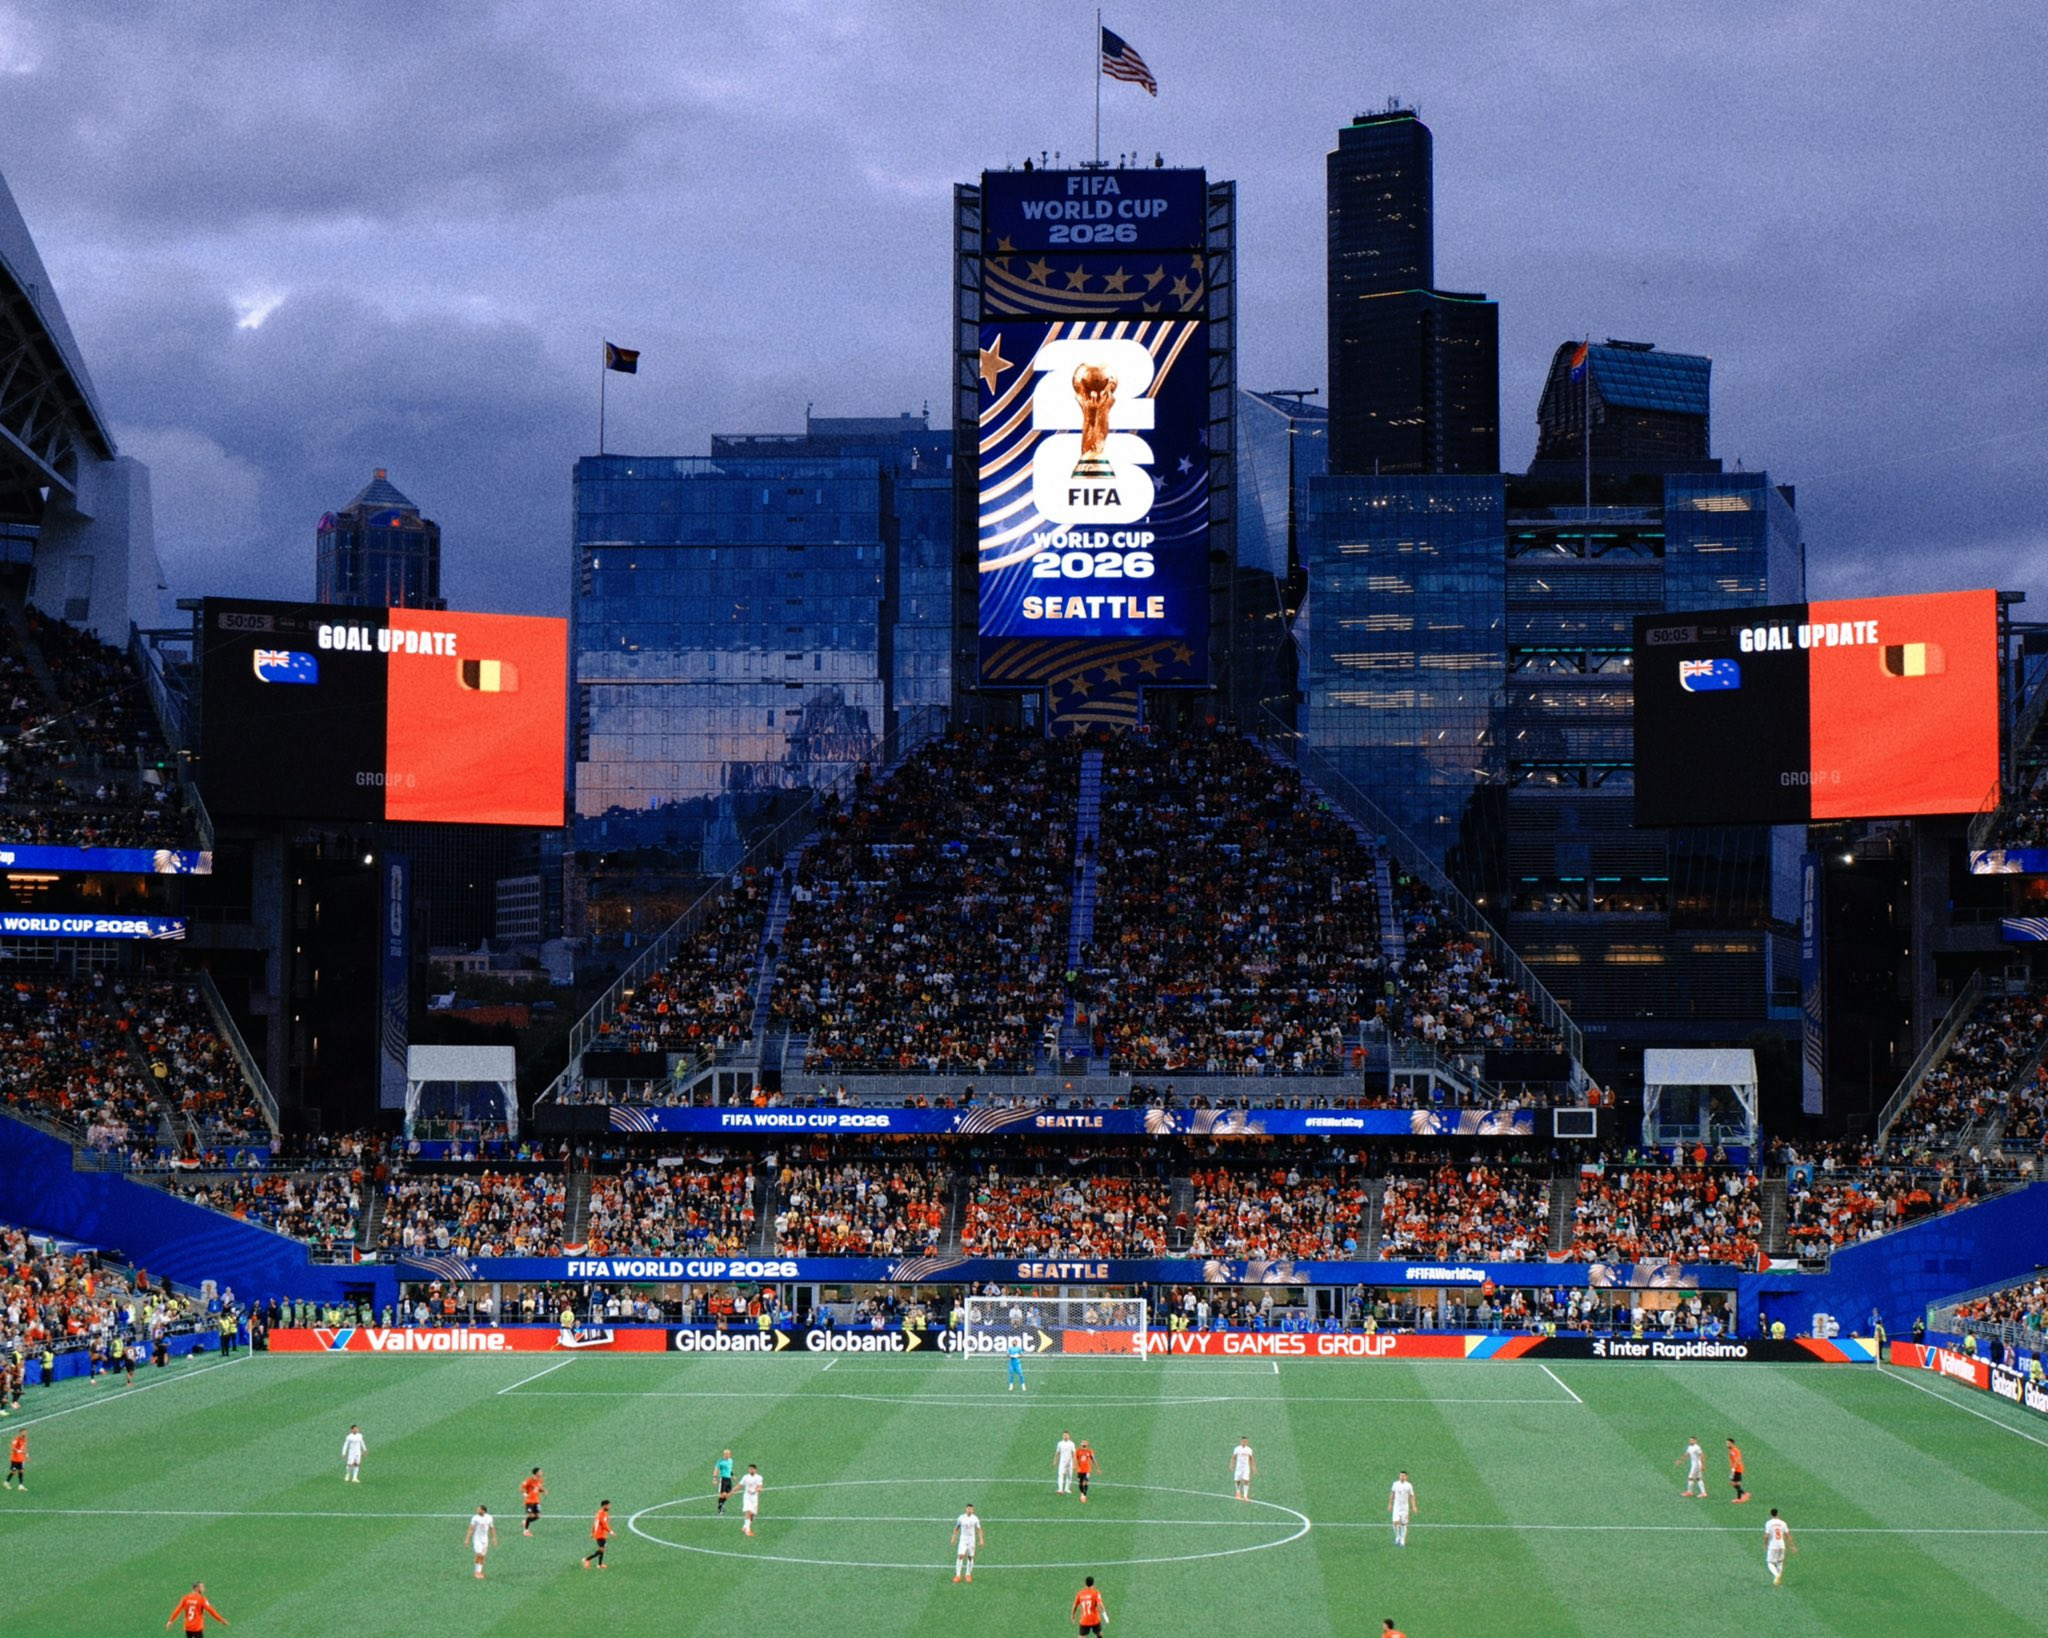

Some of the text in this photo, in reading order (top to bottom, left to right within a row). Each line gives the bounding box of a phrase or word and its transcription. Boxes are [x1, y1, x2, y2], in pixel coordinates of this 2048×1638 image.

[1067, 176, 1120, 195] FIFA
[1022, 199, 1168, 220] WORLD CUP
[1049, 224, 1138, 243] 2026
[1068, 489, 1121, 506] FIFA
[1033, 532, 1154, 549] WORLD CUP
[1032, 552, 1155, 578] 2026
[1022, 596, 1165, 619] SEATTLE
[226, 615, 265, 629] 50:05
[318, 625, 372, 651] GOAL
[378, 629, 457, 657] UPDATE
[1652, 628, 1689, 642] 50:05
[1740, 627, 1793, 652] GOAL
[1798, 620, 1879, 649] UPDATE
[356, 772, 416, 788] GROUP G
[1780, 770, 1841, 786] GROUP G
[4, 918, 61, 931] WORLD
[62, 919, 93, 932] CUP
[95, 920, 148, 933] 2026
[722, 1114, 889, 1127] FIFA WORLD CUP 2026
[1036, 1116, 1103, 1128] SEATTLE
[568, 1261, 798, 1277] FIFA WORLD CUP 2026
[1018, 1263, 1109, 1279] SEATTLE
[1405, 1267, 1486, 1283] #FIFAWorldCup
[366, 1329, 505, 1350] Valvoline
[675, 1329, 773, 1351] Globant
[806, 1330, 903, 1351] Globant
[1223, 1334, 1306, 1354] GAMES
[1317, 1334, 1397, 1356] GROUP
[1609, 1341, 1748, 1360] Inter Rapidísimo
[1939, 1349, 1976, 1383] Valvoline
[1991, 1368, 2017, 1400] Globant
[188, 1604, 196, 1621] 5
